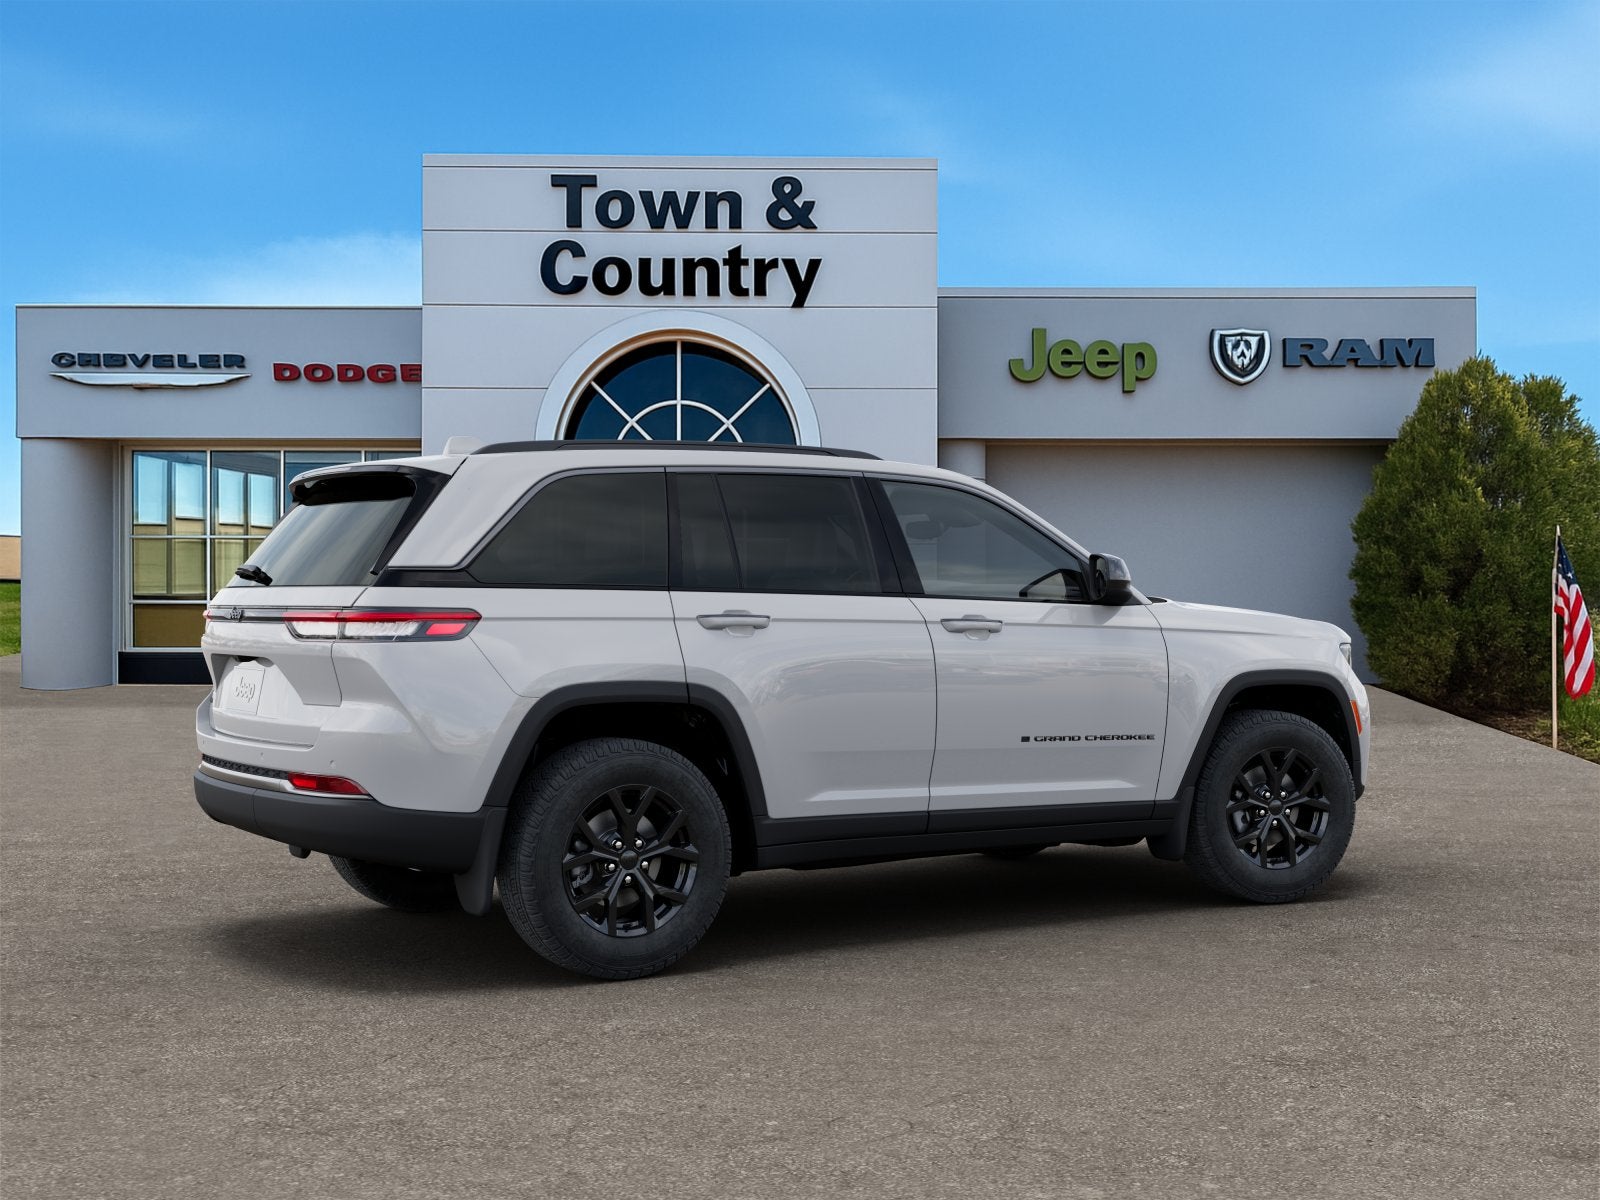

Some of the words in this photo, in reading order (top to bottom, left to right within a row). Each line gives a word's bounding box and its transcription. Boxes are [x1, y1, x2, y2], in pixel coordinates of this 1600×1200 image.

[551, 174, 742, 229] Town
[765, 175, 818, 230] &
[540, 239, 822, 308] Country
[1008, 328, 1157, 392] Jeep
[1282, 337, 1435, 368] RAM
